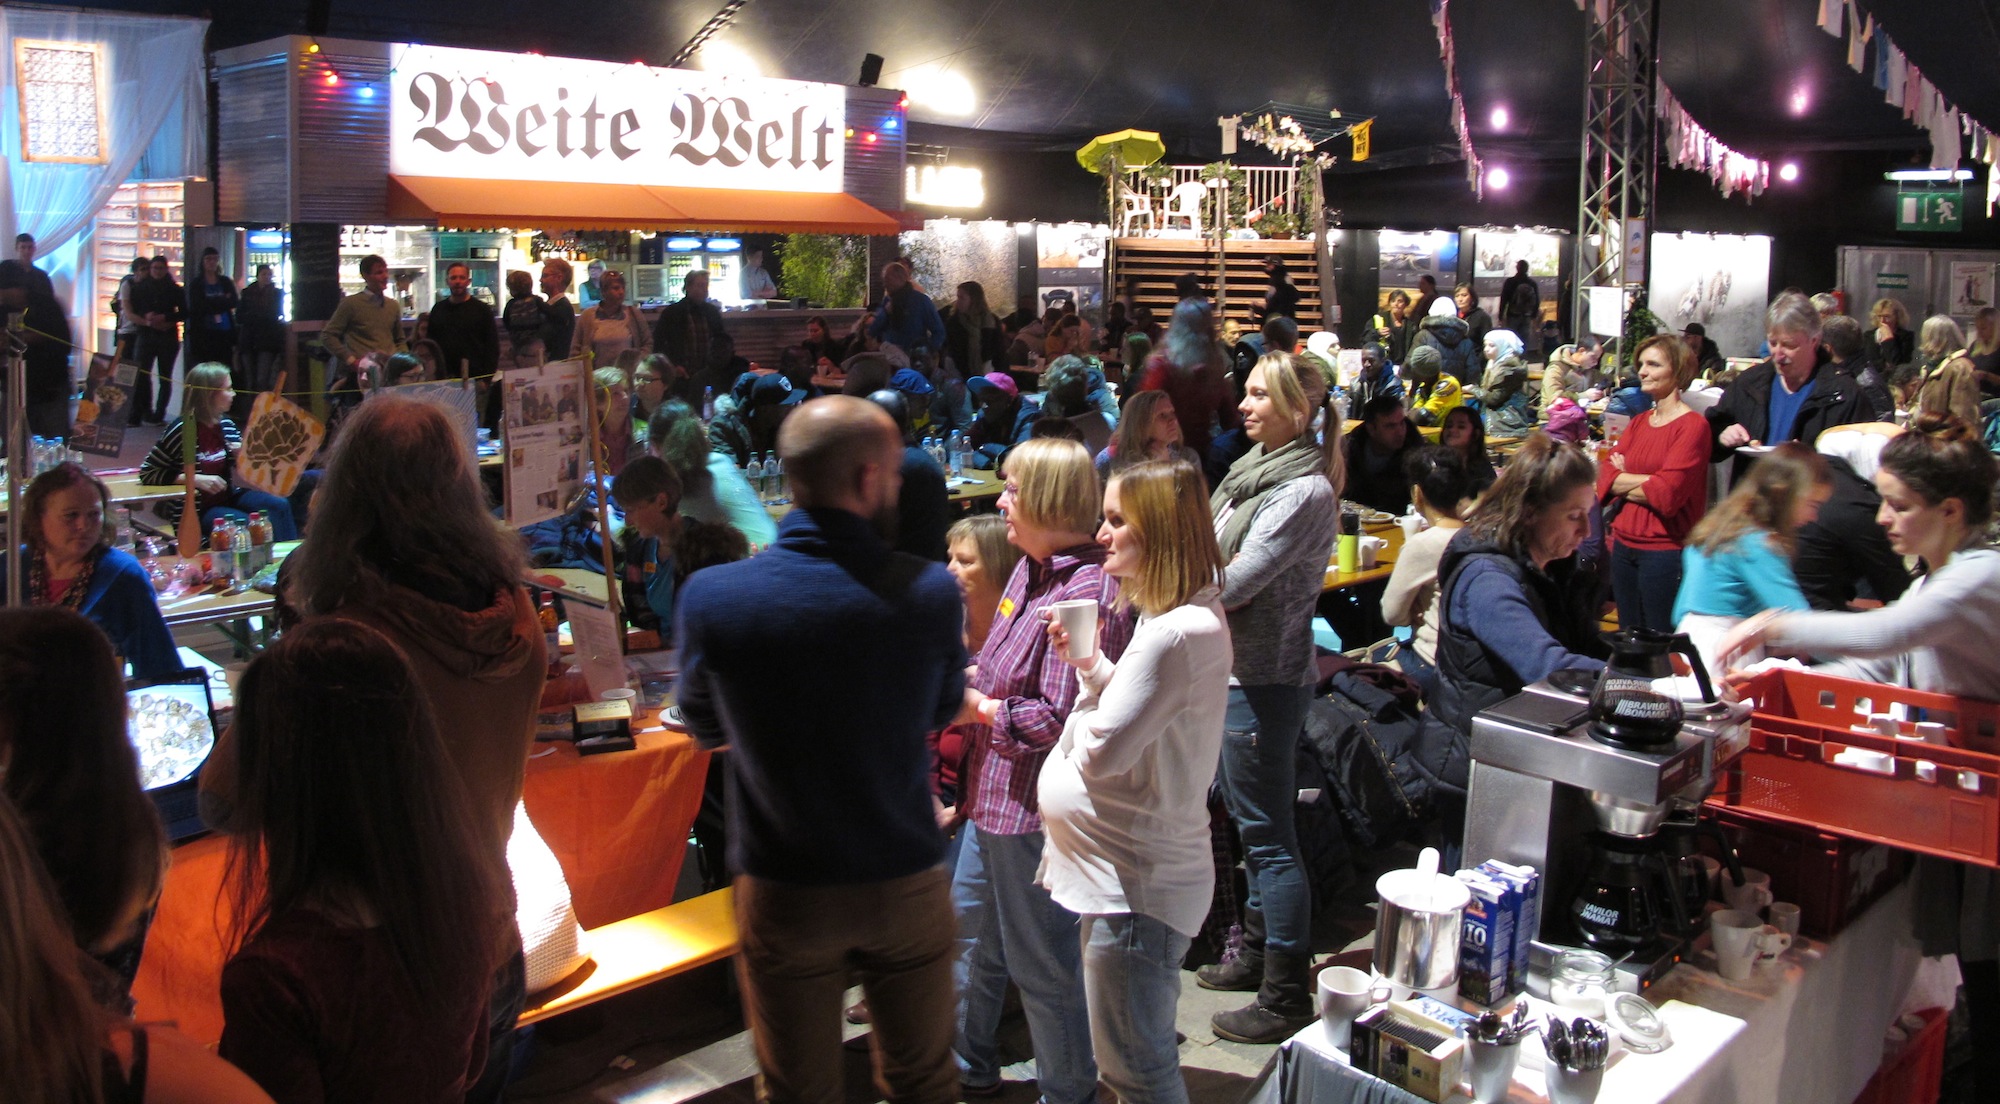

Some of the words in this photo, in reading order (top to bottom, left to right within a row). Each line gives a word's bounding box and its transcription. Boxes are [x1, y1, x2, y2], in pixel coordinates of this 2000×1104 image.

[409, 71, 641, 161] Weite
[669, 92, 835, 171] Welt
[1627, 700, 1670, 710] BRAVILOR
[1624, 708, 1670, 718] BONAMAT
